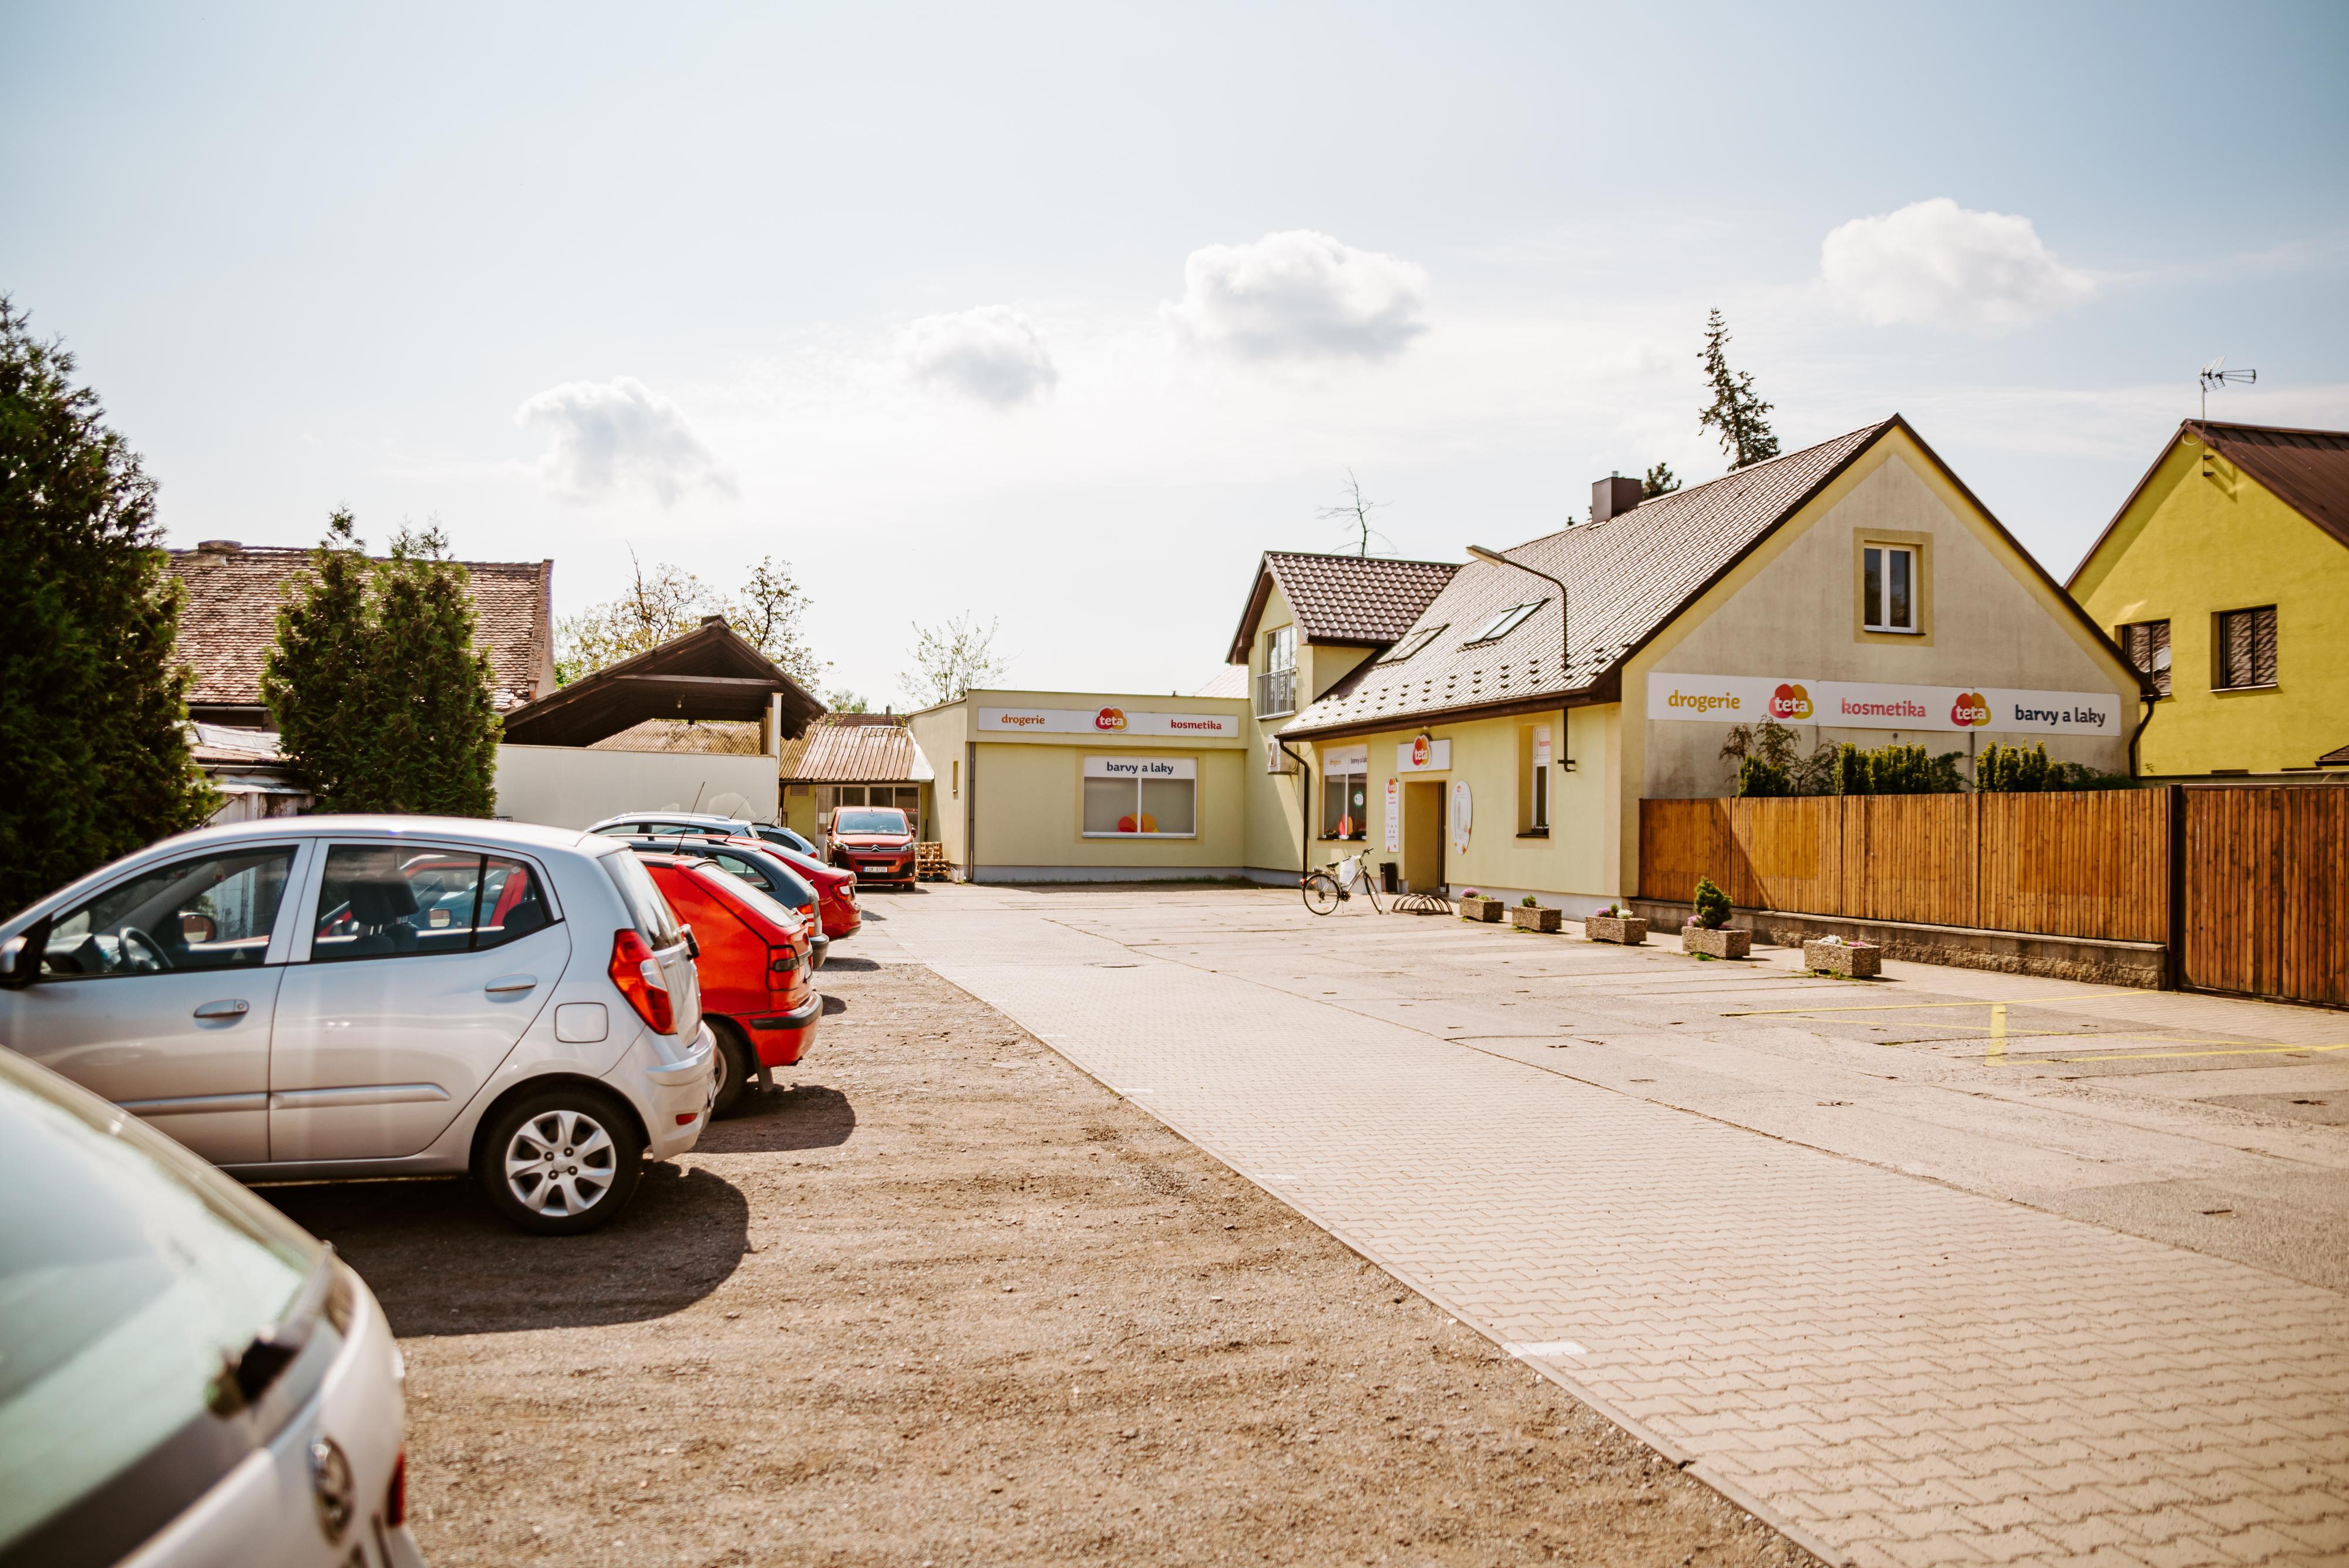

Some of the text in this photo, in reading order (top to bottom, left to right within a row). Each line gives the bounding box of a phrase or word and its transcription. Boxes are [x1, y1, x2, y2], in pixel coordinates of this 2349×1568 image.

[1668, 689, 2106, 728] drogerie teta kosmetika teta barvy a laky
[1001, 714, 1222, 730] drogerie teta kosmetika
[1539, 739, 1550, 748] kosm
[1414, 748, 1428, 761] teta
[1106, 761, 1174, 775] barvy a laky
